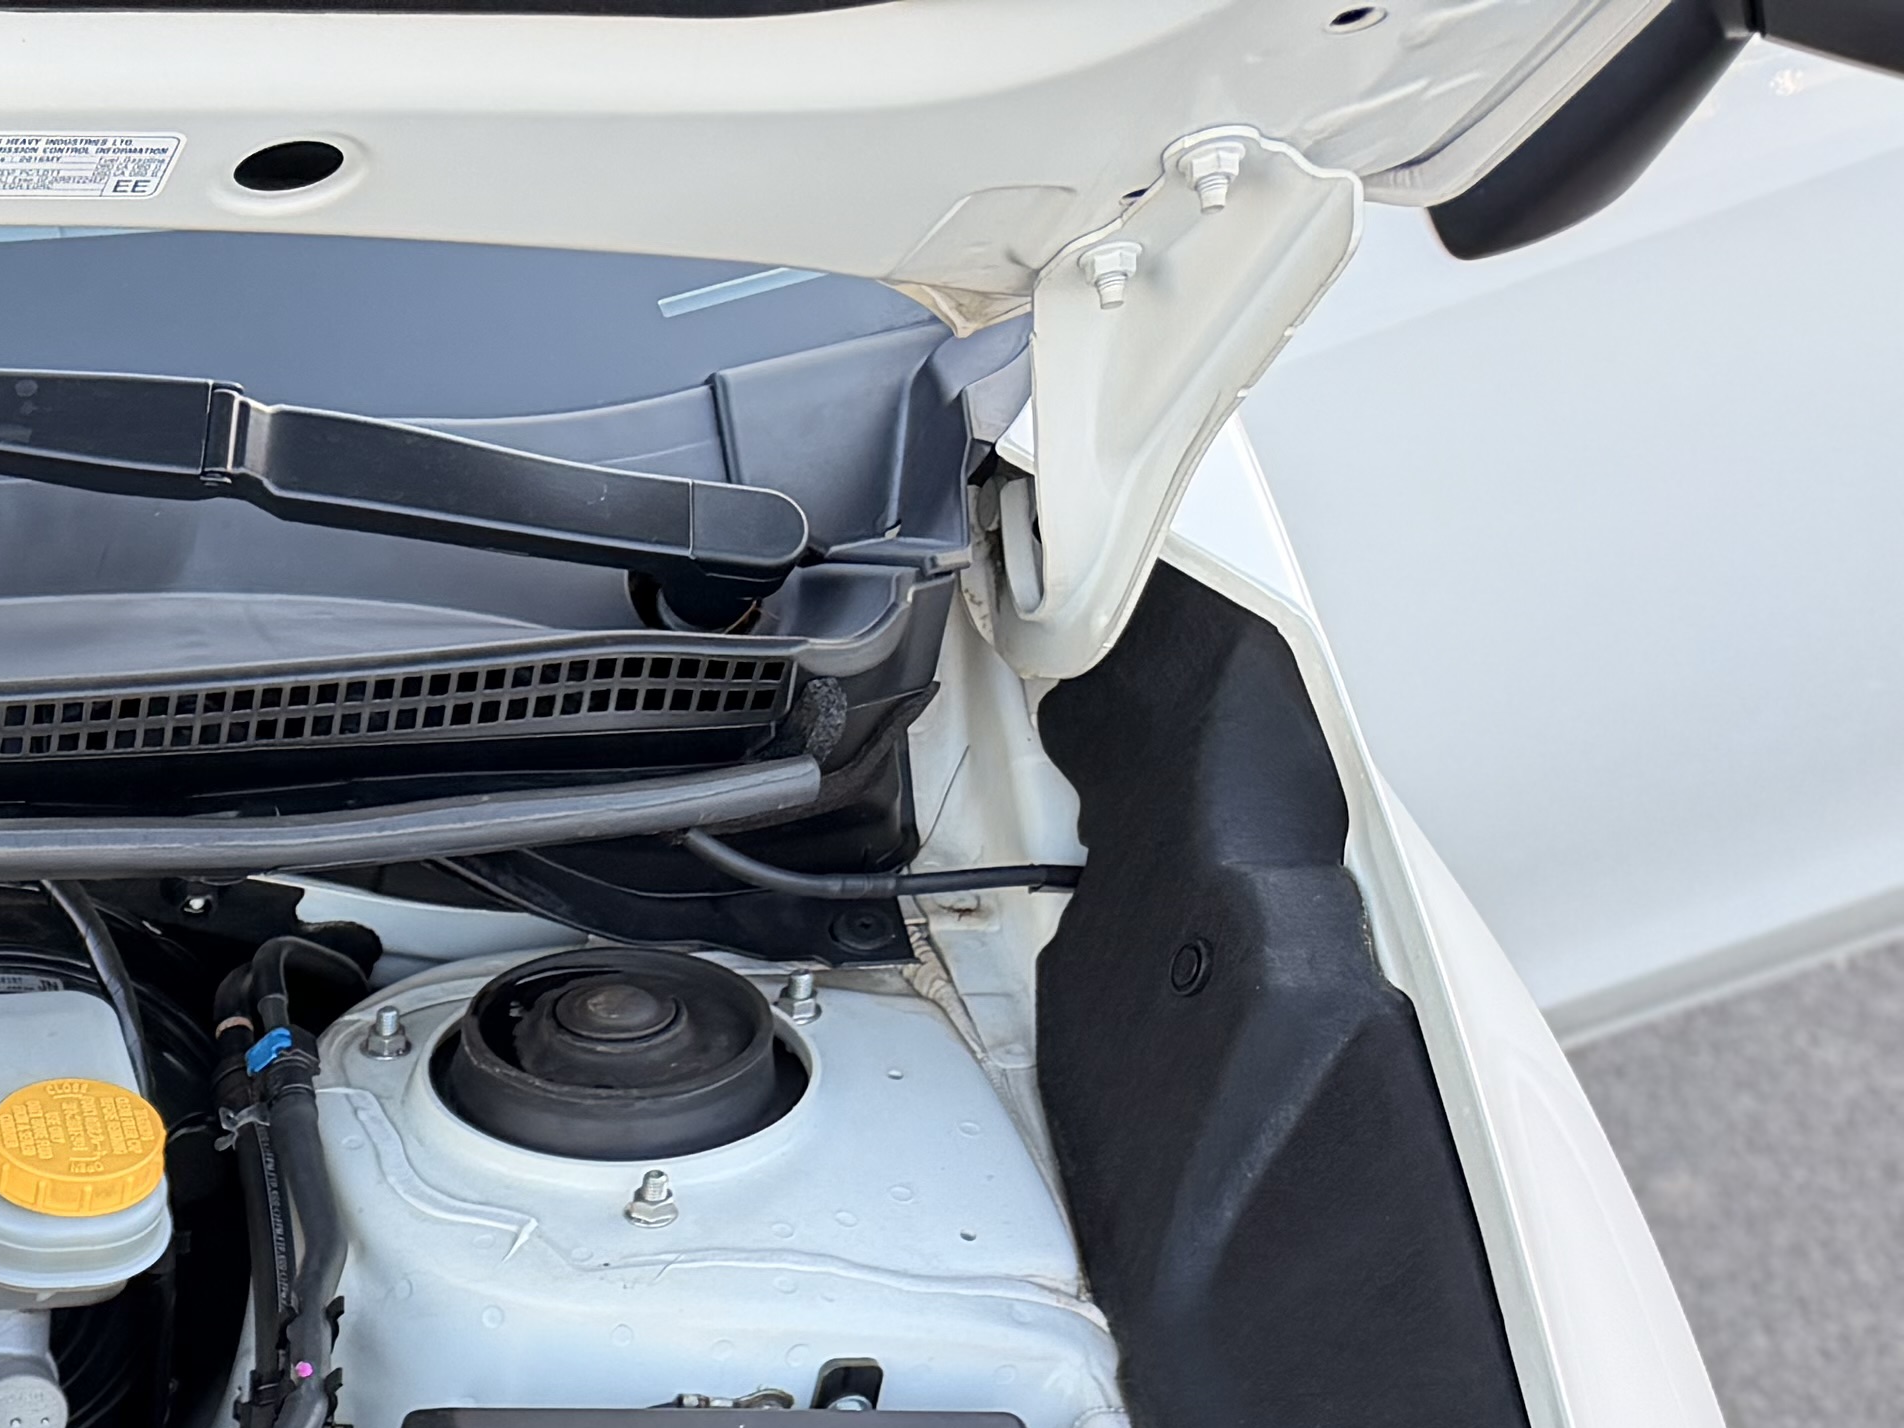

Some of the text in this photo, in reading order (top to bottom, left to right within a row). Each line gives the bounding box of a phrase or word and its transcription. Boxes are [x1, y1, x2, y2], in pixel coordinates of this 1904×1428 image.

[5, 138, 41, 146] HEAVY
[46, 138, 108, 147] INDUSTRIES
[43, 147, 90, 155] CONTROL
[95, 147, 169, 156] INFORMATION
[112, 179, 151, 193] EE
[46, 1082, 89, 1095] CLOSE
